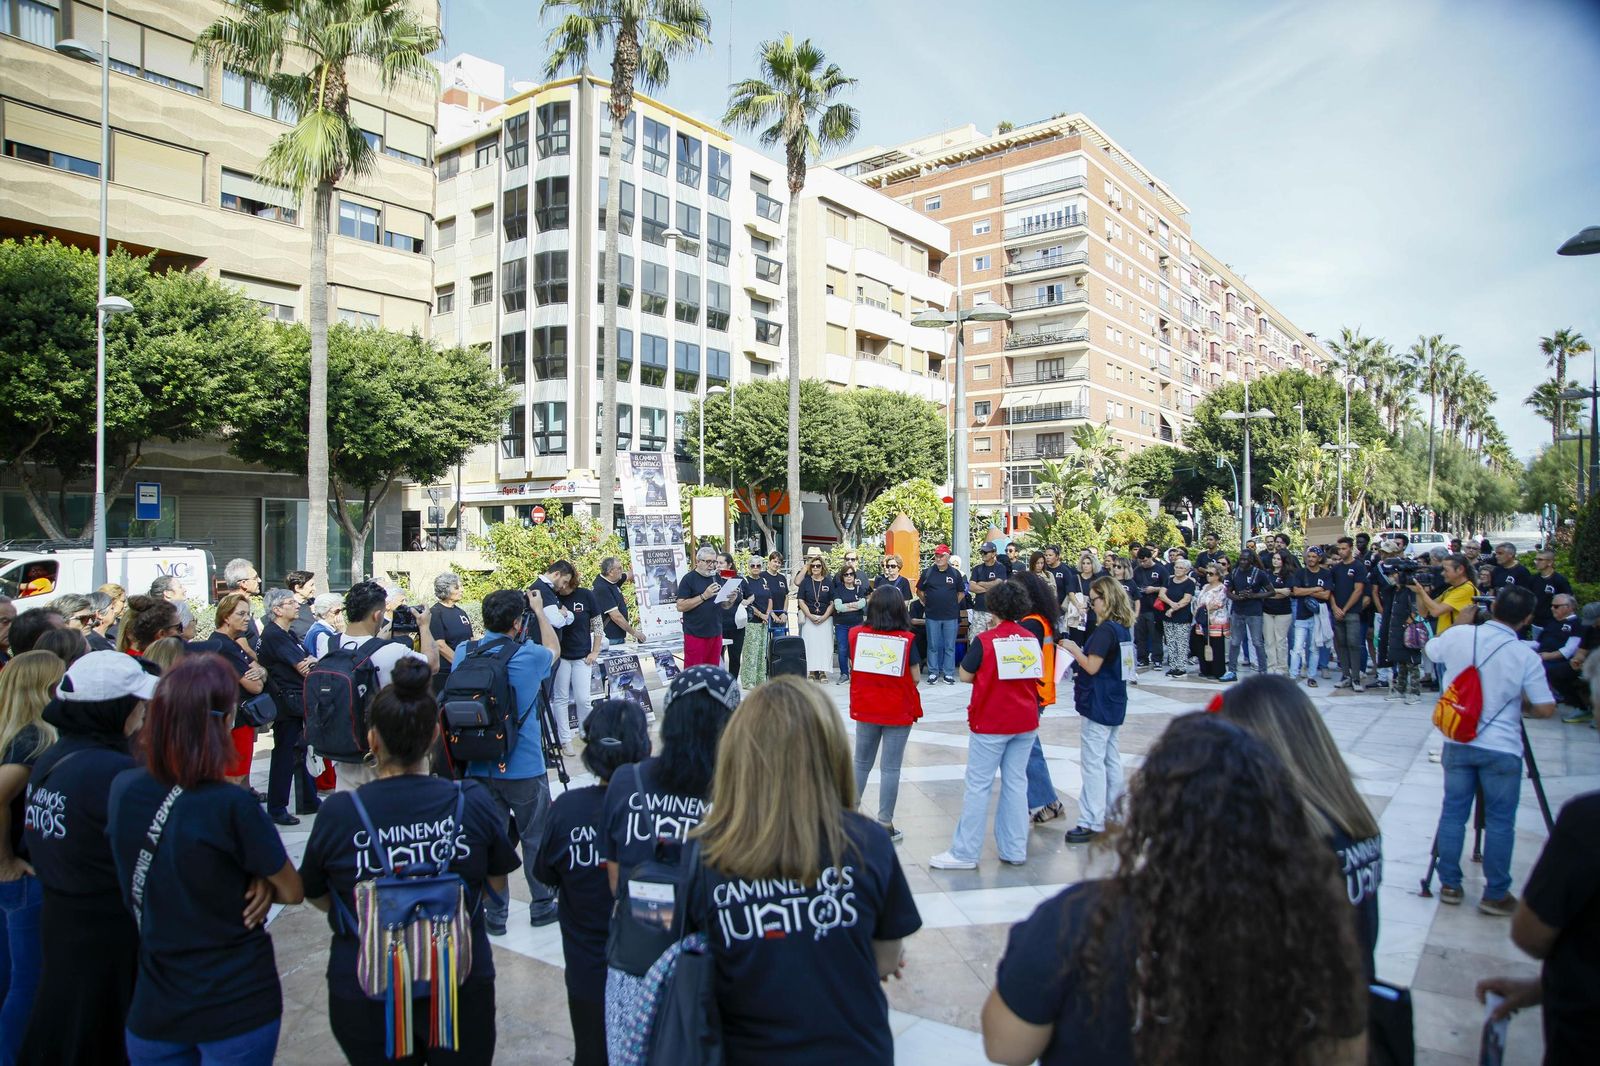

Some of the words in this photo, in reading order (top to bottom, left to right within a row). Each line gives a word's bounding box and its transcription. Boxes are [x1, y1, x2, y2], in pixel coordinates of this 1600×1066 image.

[615, 656, 633, 666] CAMINO
[615, 662, 638, 672] SANTIAGO
[147, 784, 183, 846] BIMBAY
